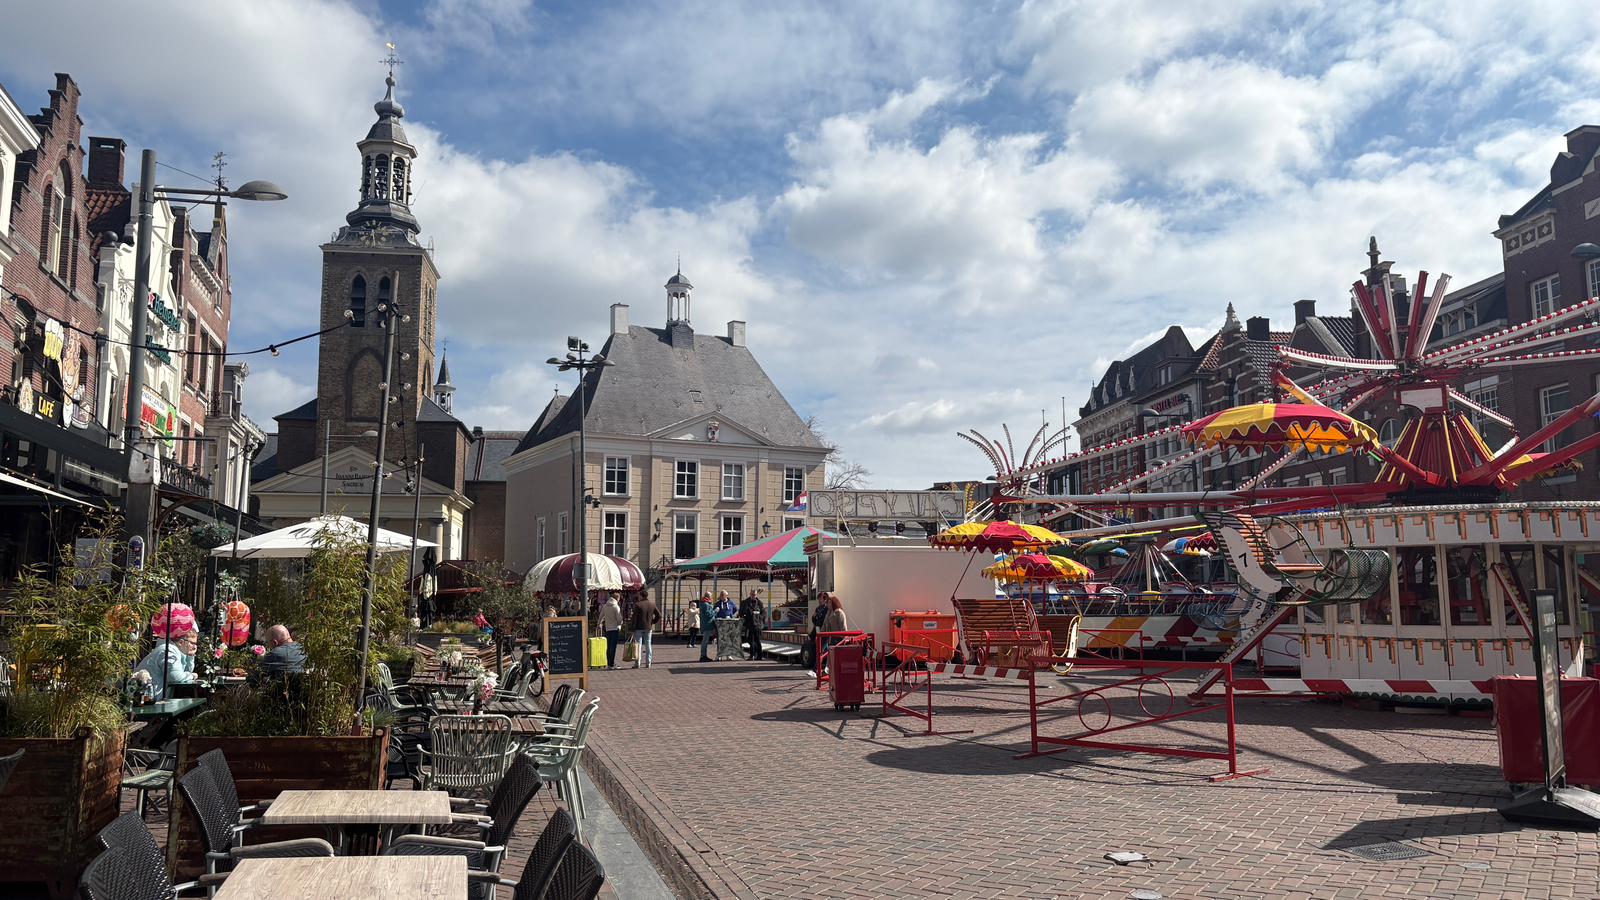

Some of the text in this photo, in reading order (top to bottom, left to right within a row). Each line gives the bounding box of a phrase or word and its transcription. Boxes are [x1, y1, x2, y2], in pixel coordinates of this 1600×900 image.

[154, 294, 181, 332] Heineken
[38, 395, 56, 418] CAFÉ
[1238, 552, 1248, 567] 7
[1255, 601, 1262, 609] 2
